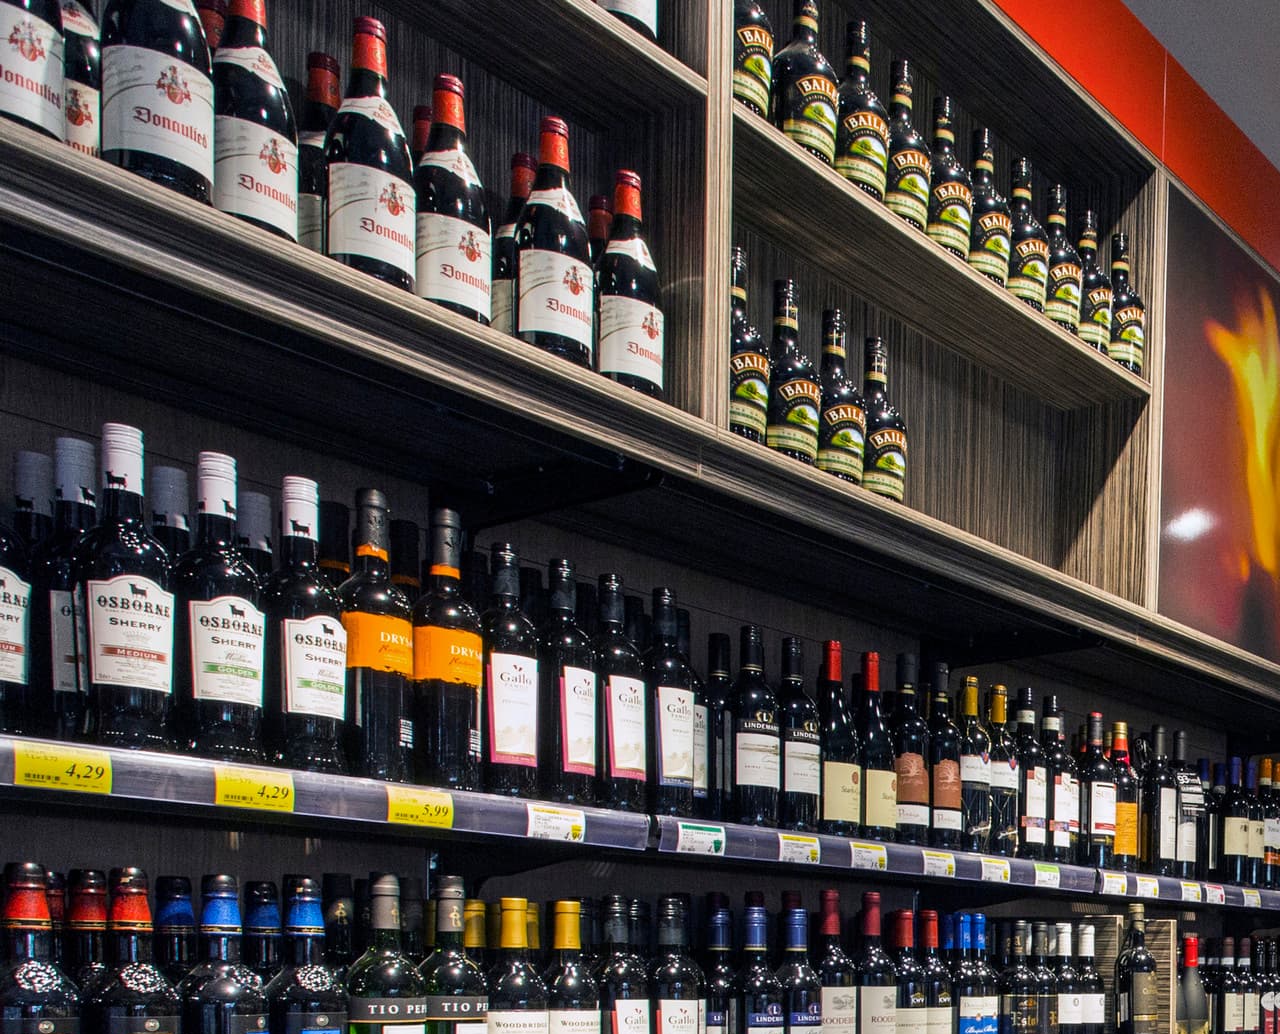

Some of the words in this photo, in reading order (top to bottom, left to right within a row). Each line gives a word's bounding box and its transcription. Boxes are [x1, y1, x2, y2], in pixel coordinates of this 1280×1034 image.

[133, 106, 208, 149] Donaulied
[97, 595, 171, 619] OSBORNE
[109, 617, 163, 632] SHERRY
[200, 615, 263, 637] OSBORNE
[211, 636, 257, 650] SHERRY
[116, 648, 158, 661] MEDIUM
[305, 653, 343, 666] SHERRY
[499, 671, 533, 686] Gallo
[65, 763, 105, 781] 4,29
[257, 784, 290, 800] 4,29
[422, 803, 449, 818] 5,99
[368, 1004, 398, 1015] TIO
[442, 1002, 470, 1013] TIO
[668, 1015, 695, 1025] Gallo
